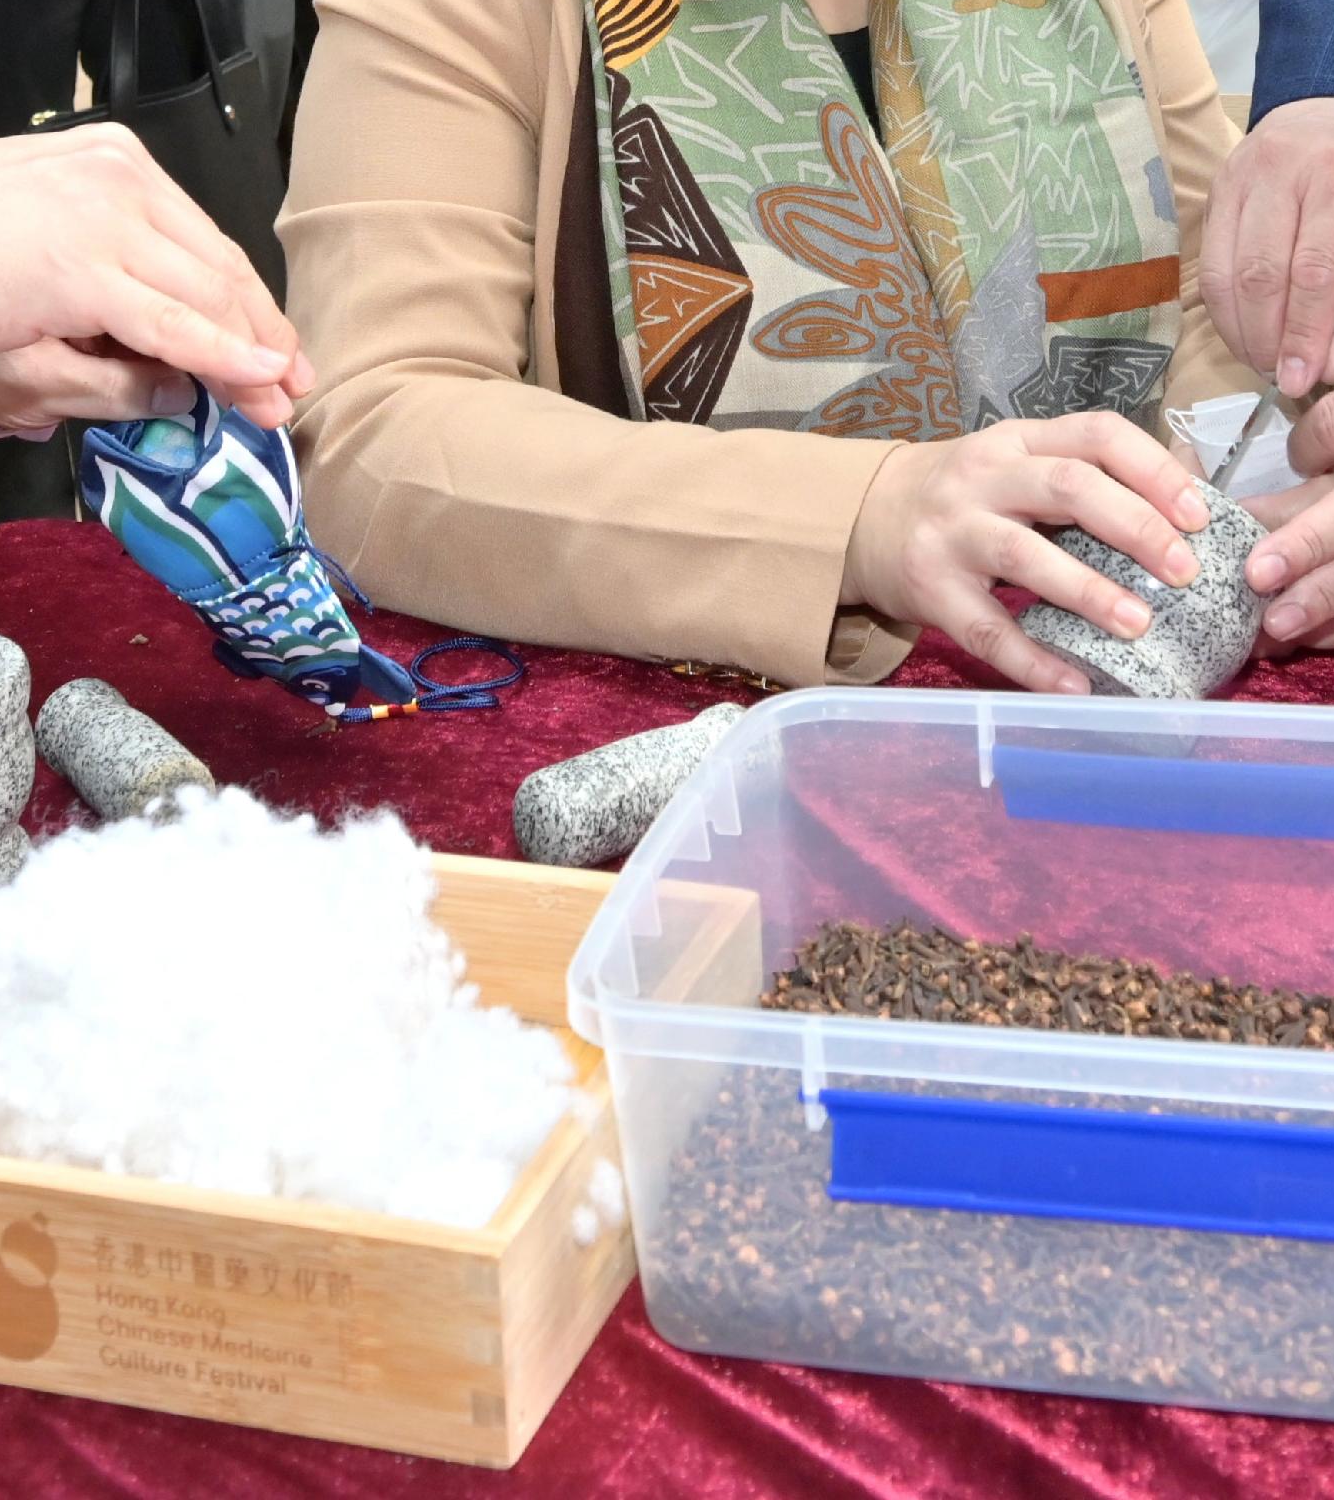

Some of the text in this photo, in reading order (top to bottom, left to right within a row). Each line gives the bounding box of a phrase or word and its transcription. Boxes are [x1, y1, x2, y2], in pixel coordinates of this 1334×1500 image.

[92, 1234, 355, 1308] 香港中醫藥文化節
[95, 1283, 226, 1329] Hong Kong
[98, 1314, 312, 1368] Chinese Medicine
[98, 1344, 286, 1395] Culture Festival
